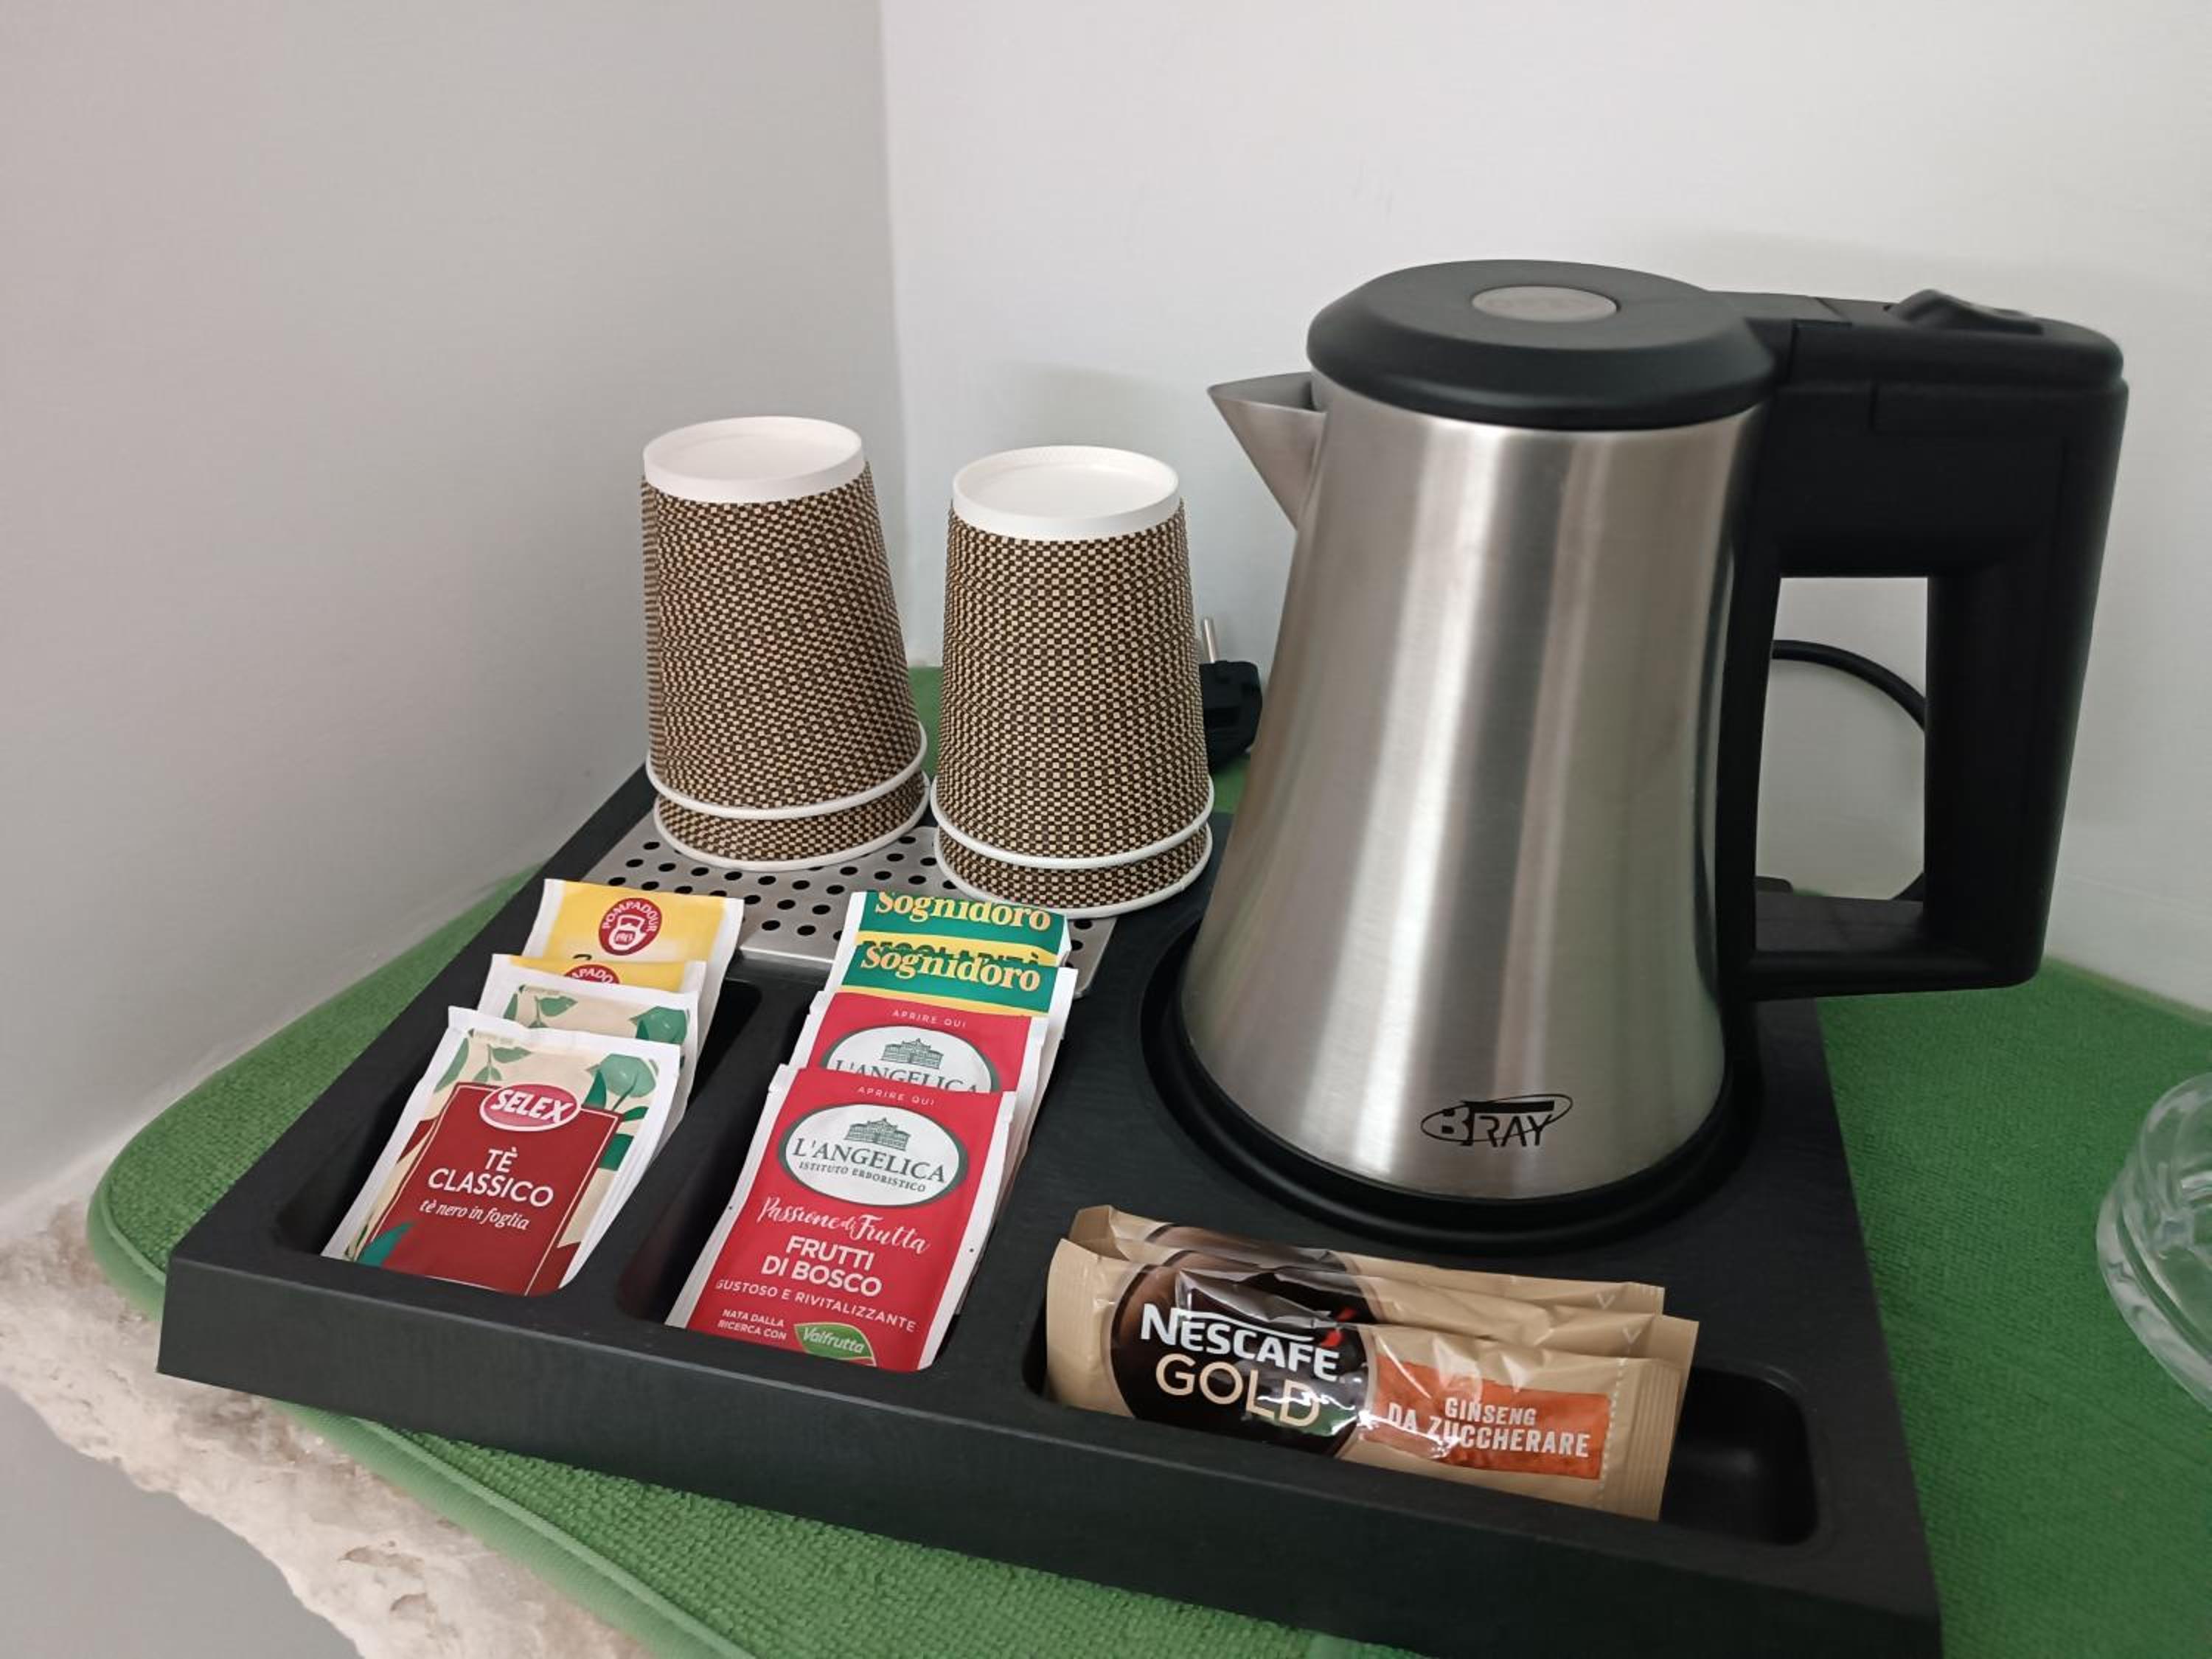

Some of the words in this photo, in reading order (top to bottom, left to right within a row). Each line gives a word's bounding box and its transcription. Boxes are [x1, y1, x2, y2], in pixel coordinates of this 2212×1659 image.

[602, 901, 659, 932] POMPADOUR
[891, 1009, 937, 1025] APRIRE
[944, 1018, 967, 1029] QUI
[490, 1089, 573, 1124] SELEX
[858, 1086, 905, 1102] APRIRE
[484, 1147, 518, 1173] TÈ
[793, 1138, 946, 1183] L'ANGELICA
[799, 1161, 849, 1175] ISTITUTO
[852, 1168, 926, 1192] ERBORISTICO
[428, 1168, 554, 1208] CLASSICO
[420, 1199, 437, 1212] tè
[437, 1204, 467, 1219] nero
[471, 1205, 483, 1219] in
[481, 1206, 531, 1231] foglia
[757, 1197, 841, 1229] Passione
[849, 1214, 930, 1254] Frutta
[785, 1235, 875, 1271] FRUTTI
[761, 1256, 787, 1276] DI
[791, 1261, 882, 1297] BOSCO
[715, 1279, 778, 1298] GUSTOSO
[782, 1289, 791, 1300] E
[796, 1292, 917, 1332] RIVITALIZZANTE
[722, 1309, 750, 1321] NATA
[751, 1313, 785, 1327] DALLA
[717, 1320, 761, 1335] RICERCA
[763, 1328, 787, 1340] CON
[1155, 1354, 1321, 1427] GOLD
[1444, 1397, 1537, 1427] GINSENG
[1388, 1402, 1418, 1433] DA
[1427, 1415, 1591, 1458] ZUCCHERARE
